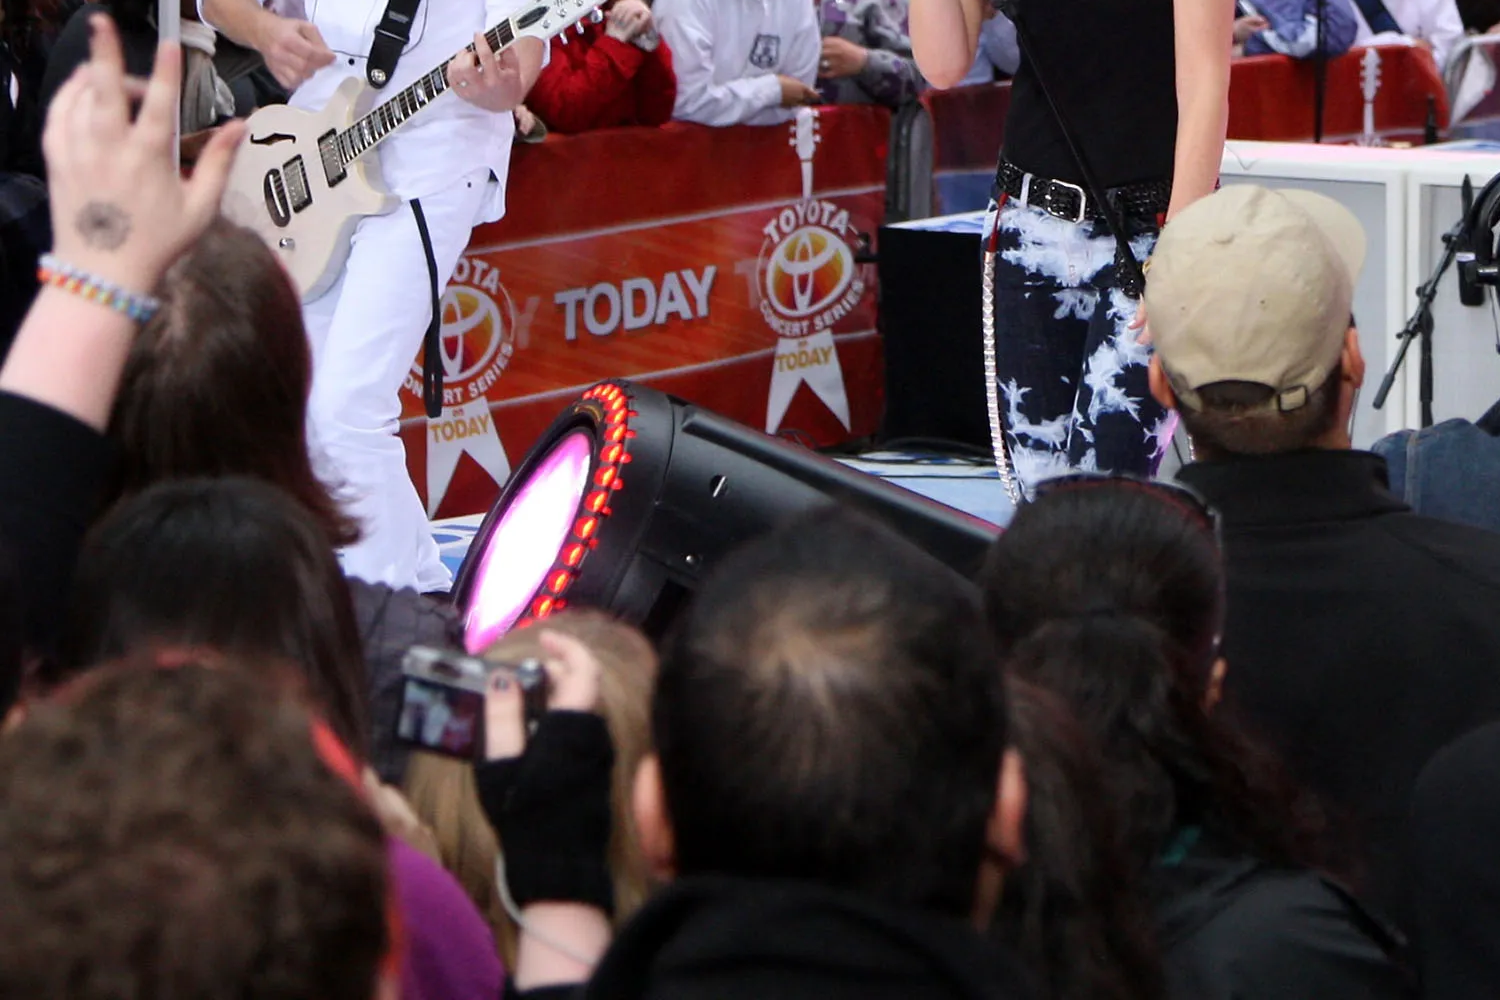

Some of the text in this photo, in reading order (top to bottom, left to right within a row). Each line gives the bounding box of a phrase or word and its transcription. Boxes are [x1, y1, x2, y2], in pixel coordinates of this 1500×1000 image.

[763, 199, 850, 244] TOYOTA
[452, 257, 500, 295] OTA
[553, 264, 718, 342] TODAY
[814, 278, 865, 331] SERIES
[468, 340, 514, 398] SERIES
[775, 346, 832, 373] TODAY
[430, 413, 490, 443] TODAY
